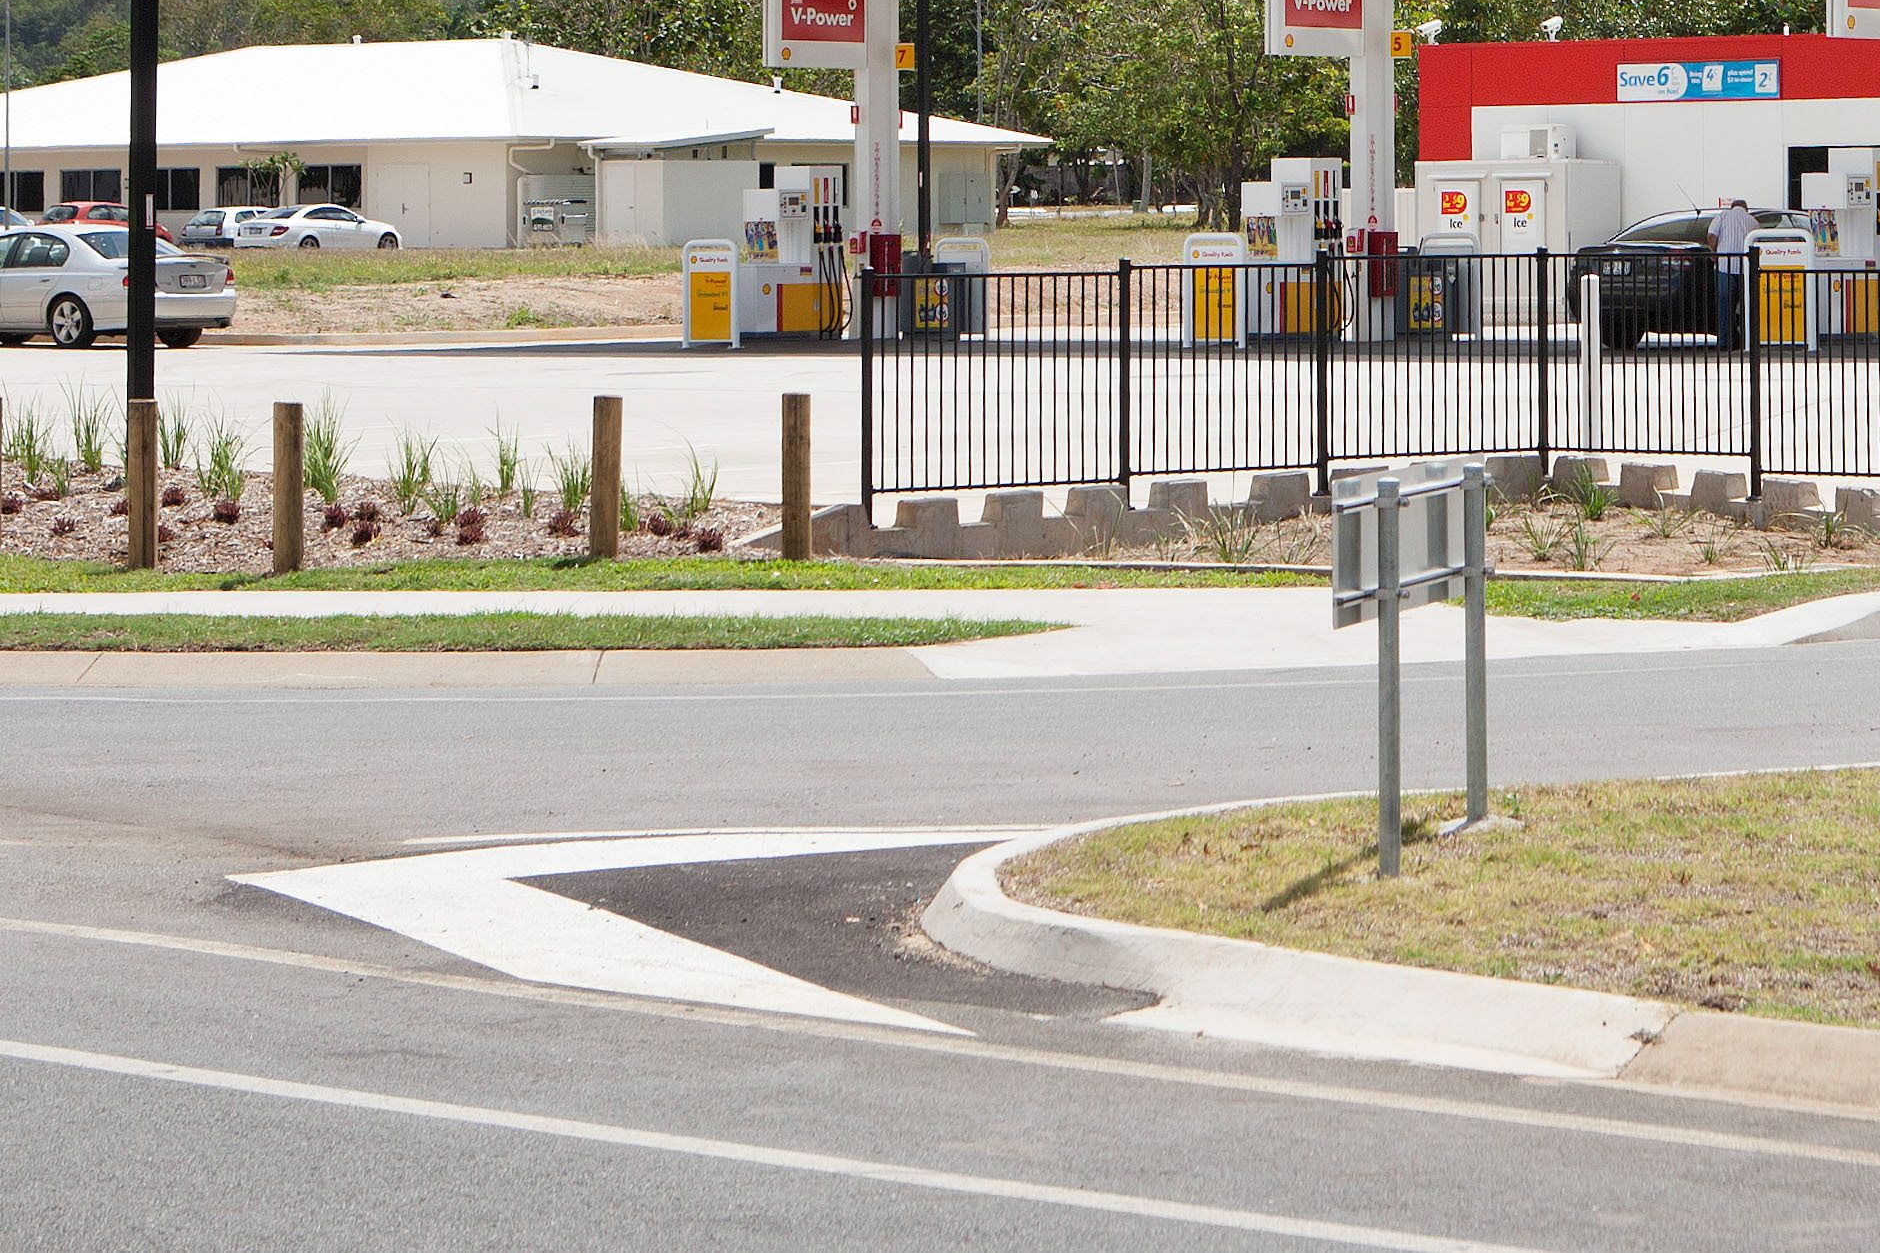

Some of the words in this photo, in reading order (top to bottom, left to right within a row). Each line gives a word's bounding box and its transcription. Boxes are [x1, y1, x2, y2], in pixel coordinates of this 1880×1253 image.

[790, 7, 854, 26] V-Power
[1393, 37, 1402, 51] 5
[898, 50, 906, 63] 7
[1619, 72, 1655, 87] Save
[1449, 219, 1463, 228] Ice
[1513, 217, 1527, 227] Ice
